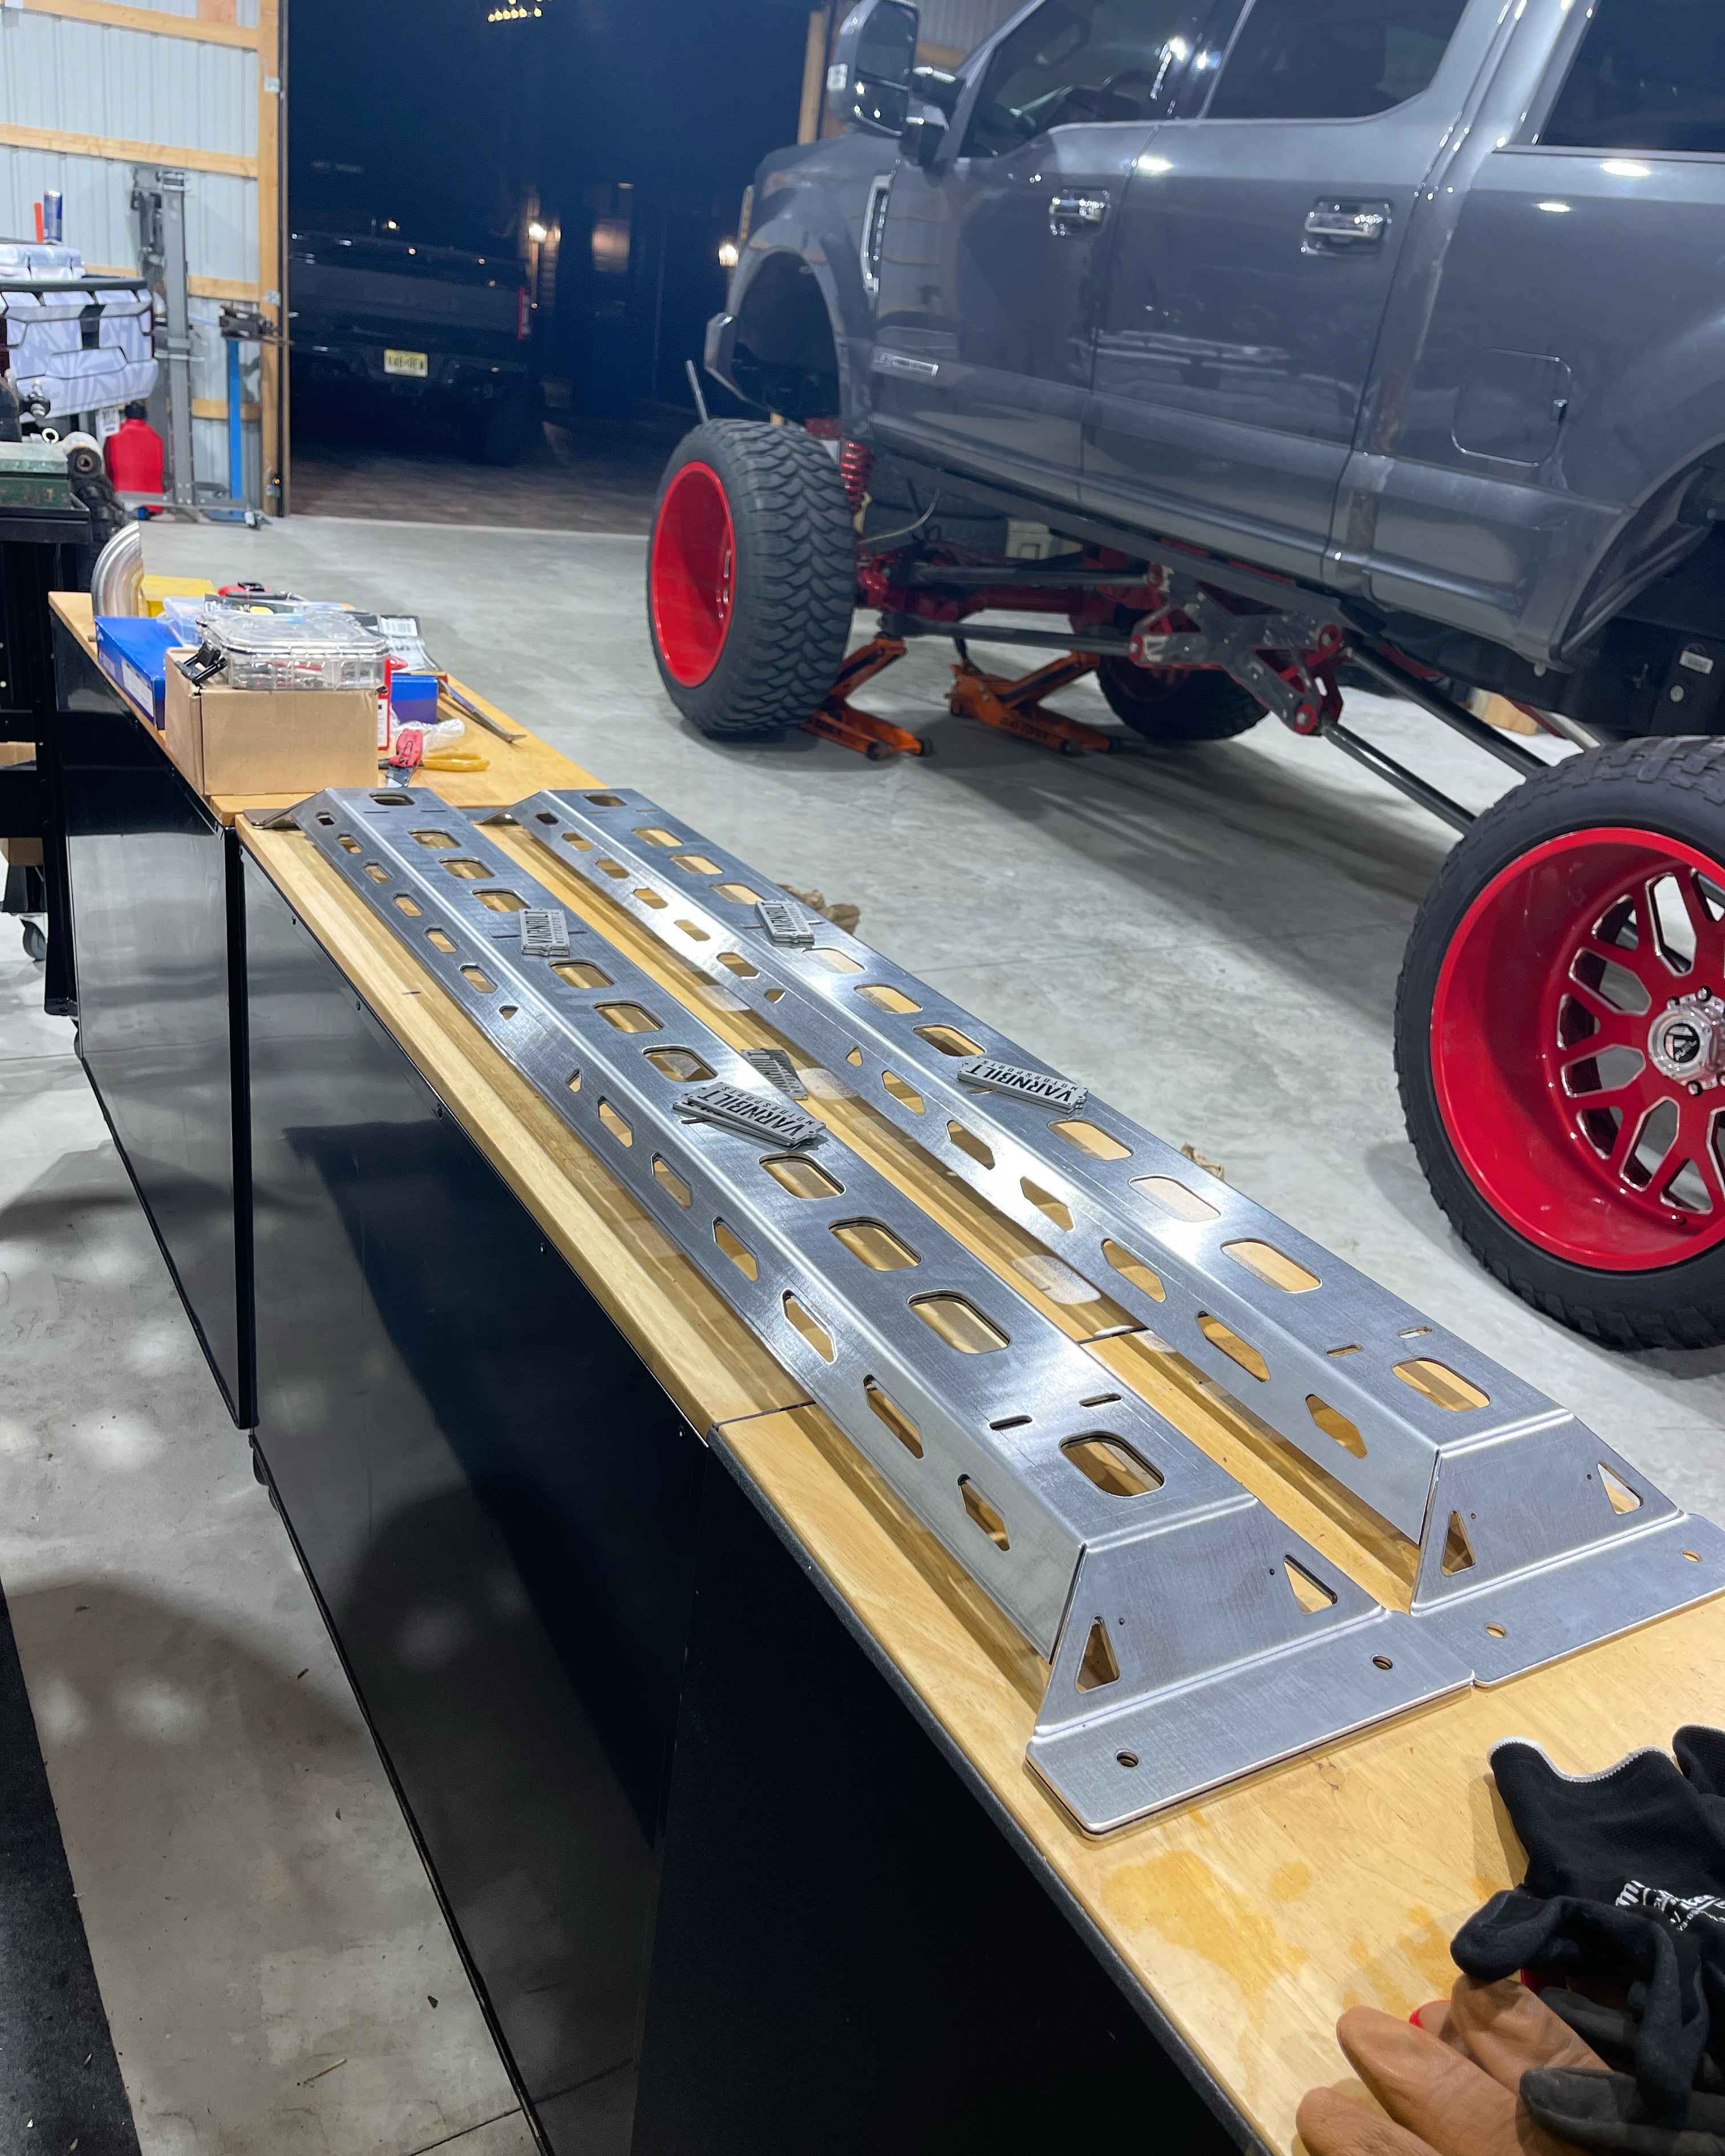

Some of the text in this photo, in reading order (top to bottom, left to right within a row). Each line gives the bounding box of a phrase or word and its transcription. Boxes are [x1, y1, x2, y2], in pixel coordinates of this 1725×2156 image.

[524, 910, 553, 944] VARNBILT
[761, 902, 798, 932] VARNBILT
[965, 1064, 1072, 1102] VARNBILT
[982, 1060, 1078, 1091] MOTORSPORTS
[697, 1090, 805, 1136] VARNBILT
[722, 1086, 816, 1125] MOTORSPORTS
